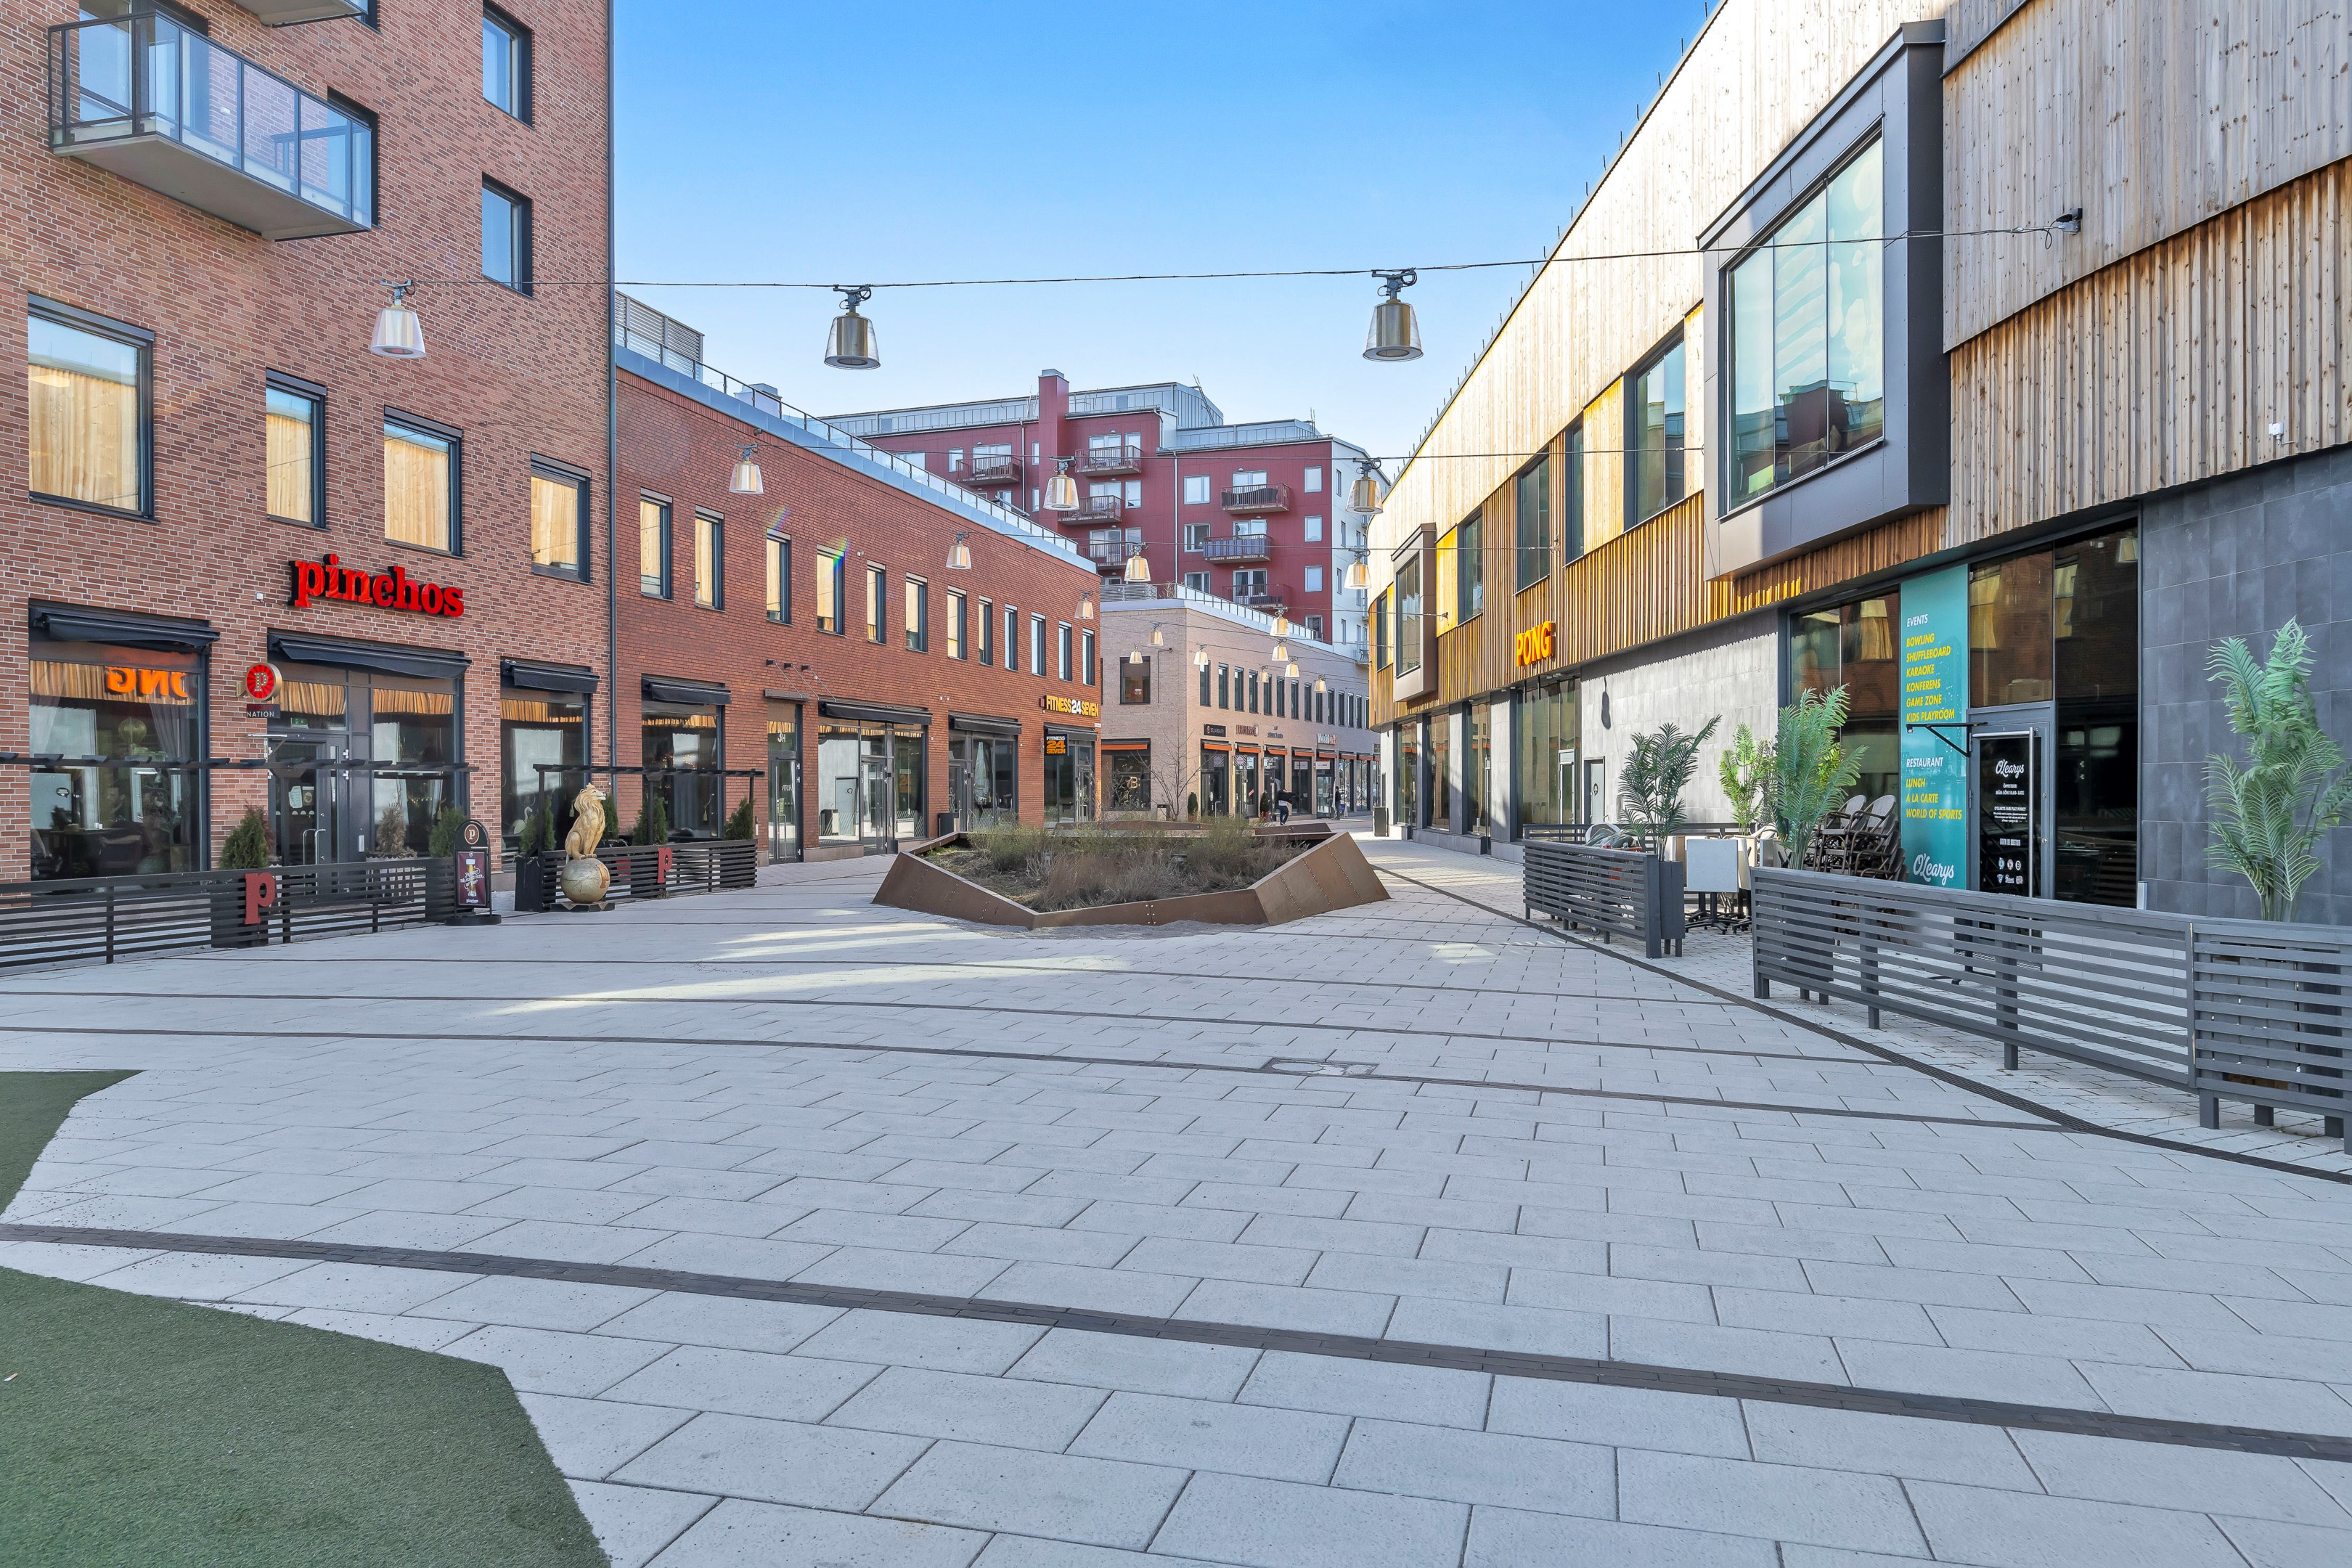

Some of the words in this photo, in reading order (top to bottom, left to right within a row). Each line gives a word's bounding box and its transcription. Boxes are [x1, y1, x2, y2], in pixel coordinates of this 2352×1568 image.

[290, 554, 464, 617] pinchos
[1907, 614, 1928, 627] EVENTS
[1516, 621, 1551, 667] PONG
[1906, 633, 1935, 648] BOWLING
[1906, 646, 1951, 662] SHUFFLEBOARD
[1906, 664, 1935, 677] KARAOKE
[1906, 679, 1941, 692] KONFERENS
[1906, 696, 1923, 707] GAME
[1925, 695, 1942, 706] ZONE
[1906, 712, 1919, 722] KIDS
[1921, 709, 1955, 721] PLAYROOM
[1046, 740, 1065, 749] 24
[1906, 757, 1943, 767] RESTAURANT
[1996, 759, 2025, 778] O'Learys
[1906, 778, 1925, 788] LUNCH
[1906, 793, 1910, 802] A
[1911, 793, 1919, 803] LA
[1920, 793, 1938, 803] CARTE
[1906, 809, 1927, 818] WORLD
[1929, 809, 1937, 818] OF
[1938, 809, 1962, 820] SPORTS
[1914, 853, 1954, 886] O'Learys
